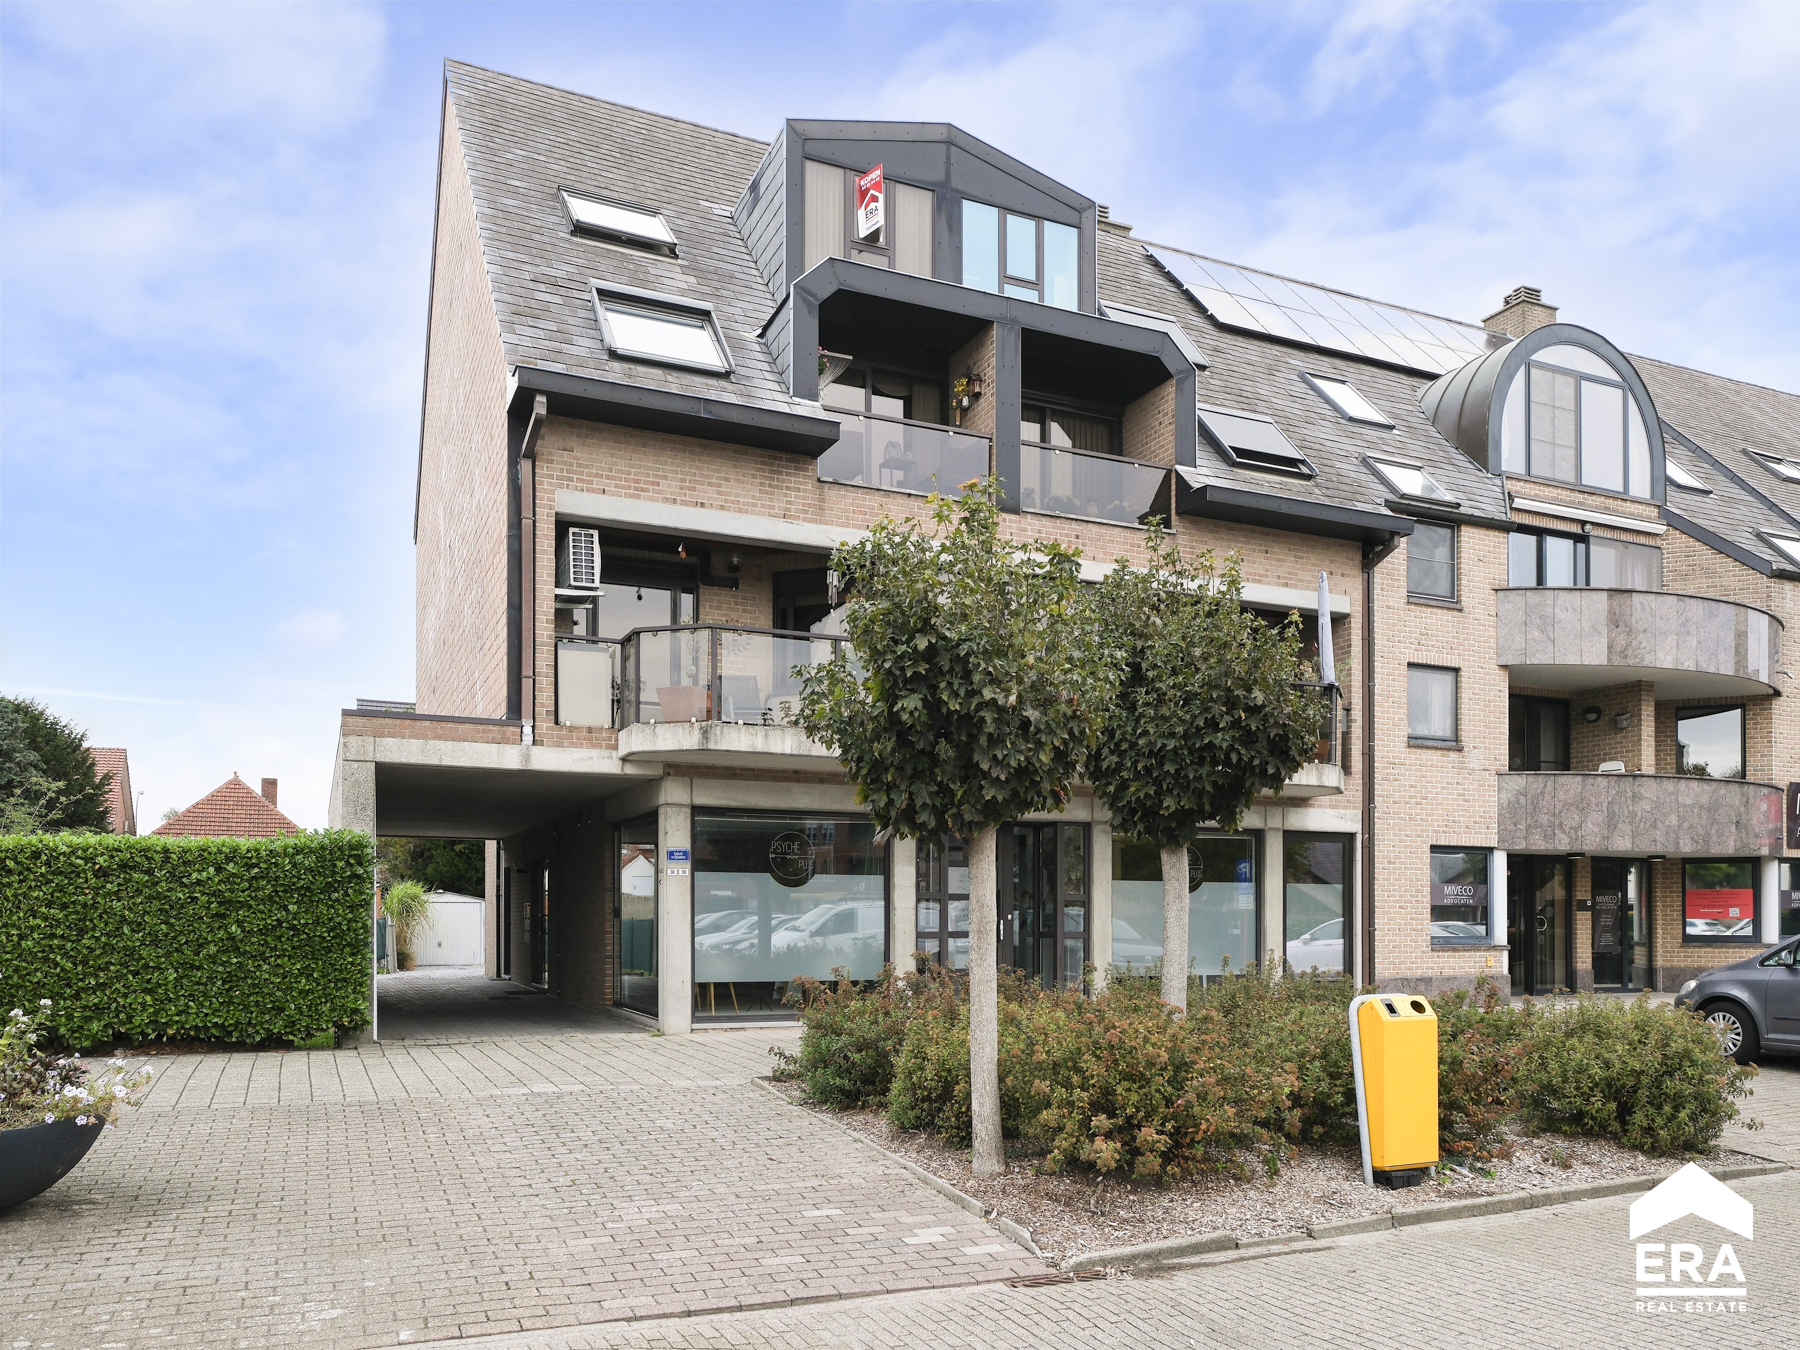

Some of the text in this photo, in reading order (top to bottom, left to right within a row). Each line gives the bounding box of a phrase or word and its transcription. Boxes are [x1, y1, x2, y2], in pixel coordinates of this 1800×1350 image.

[865, 205, 879, 219] ERA
[771, 841, 801, 853] PSYCHE
[798, 859, 815, 870] PLUS
[1190, 869, 1203, 878] PLUS
[1443, 885, 1474, 896] MIVECO
[1595, 895, 1618, 903] MIVECO
